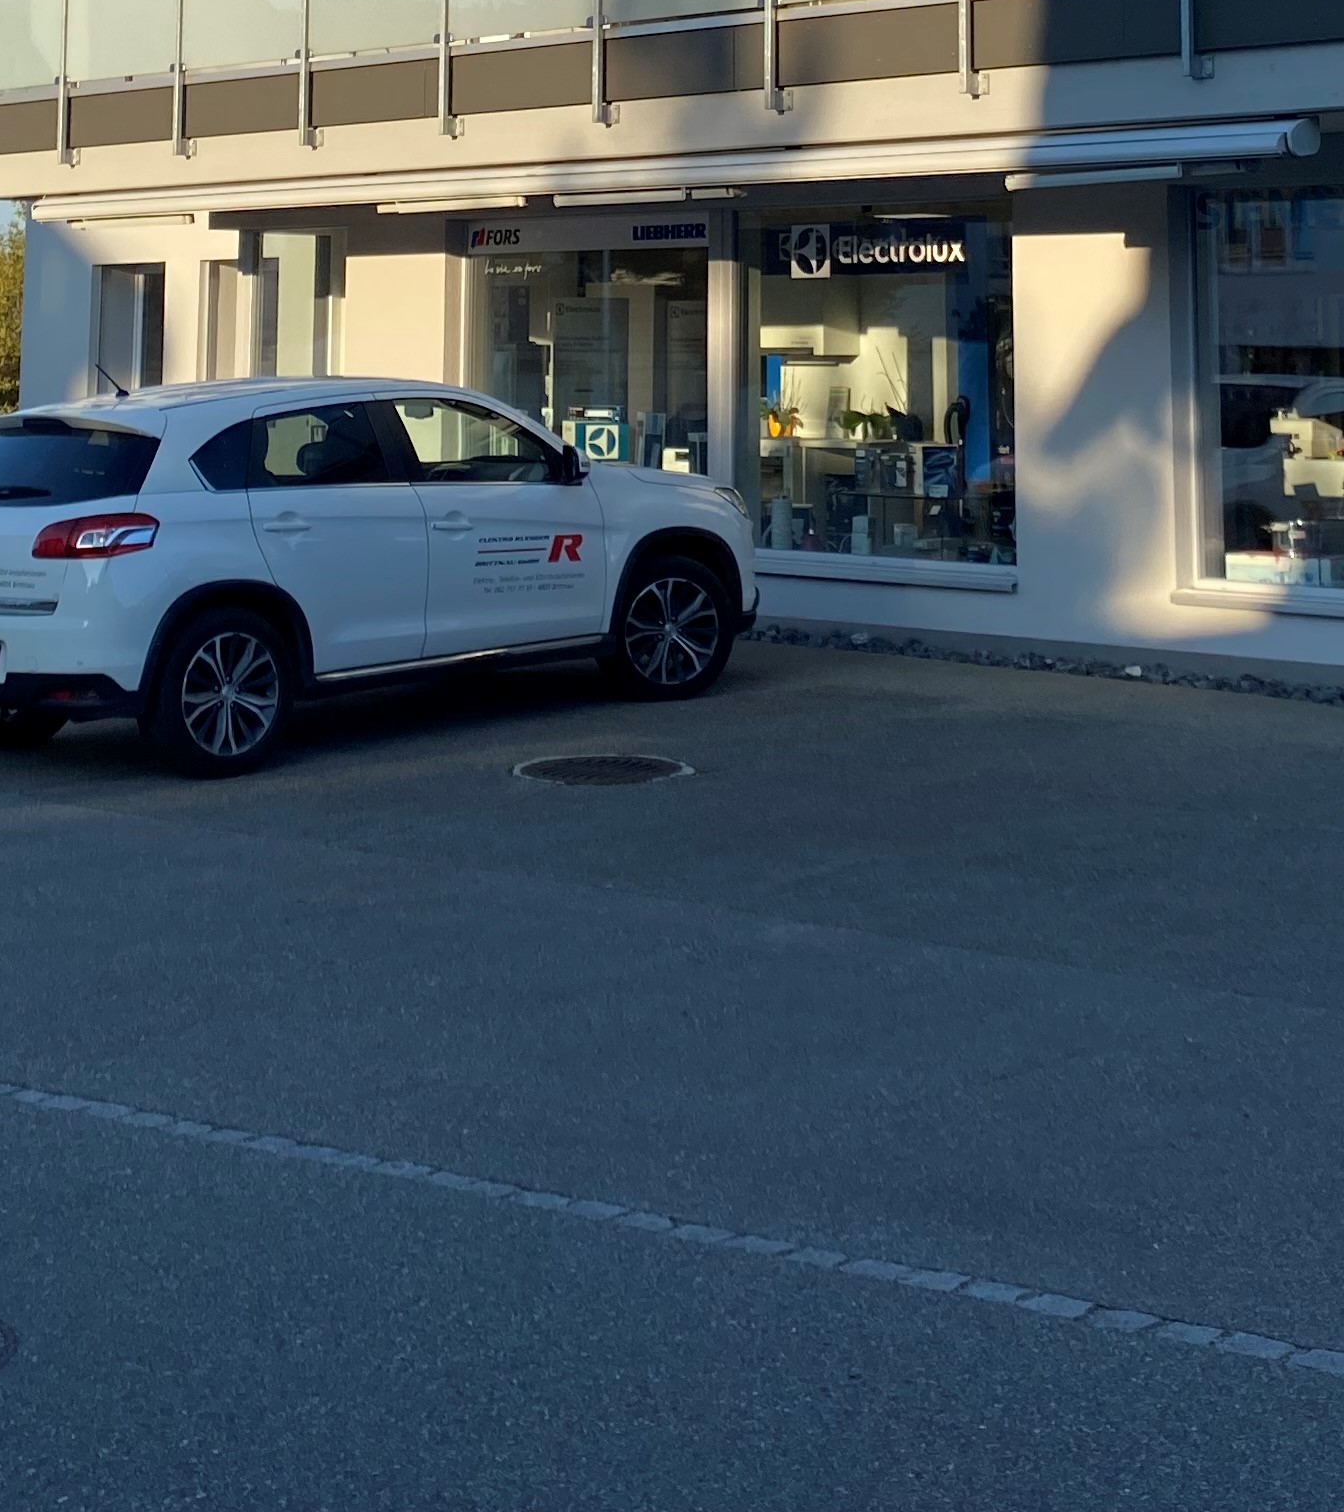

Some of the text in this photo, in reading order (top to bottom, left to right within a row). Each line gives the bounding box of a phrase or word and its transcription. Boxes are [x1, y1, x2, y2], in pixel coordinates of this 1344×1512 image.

[485, 229, 521, 245] FORS
[632, 223, 706, 241] LIEBHERR
[838, 234, 965, 264] Electrolux
[547, 534, 583, 563] R
